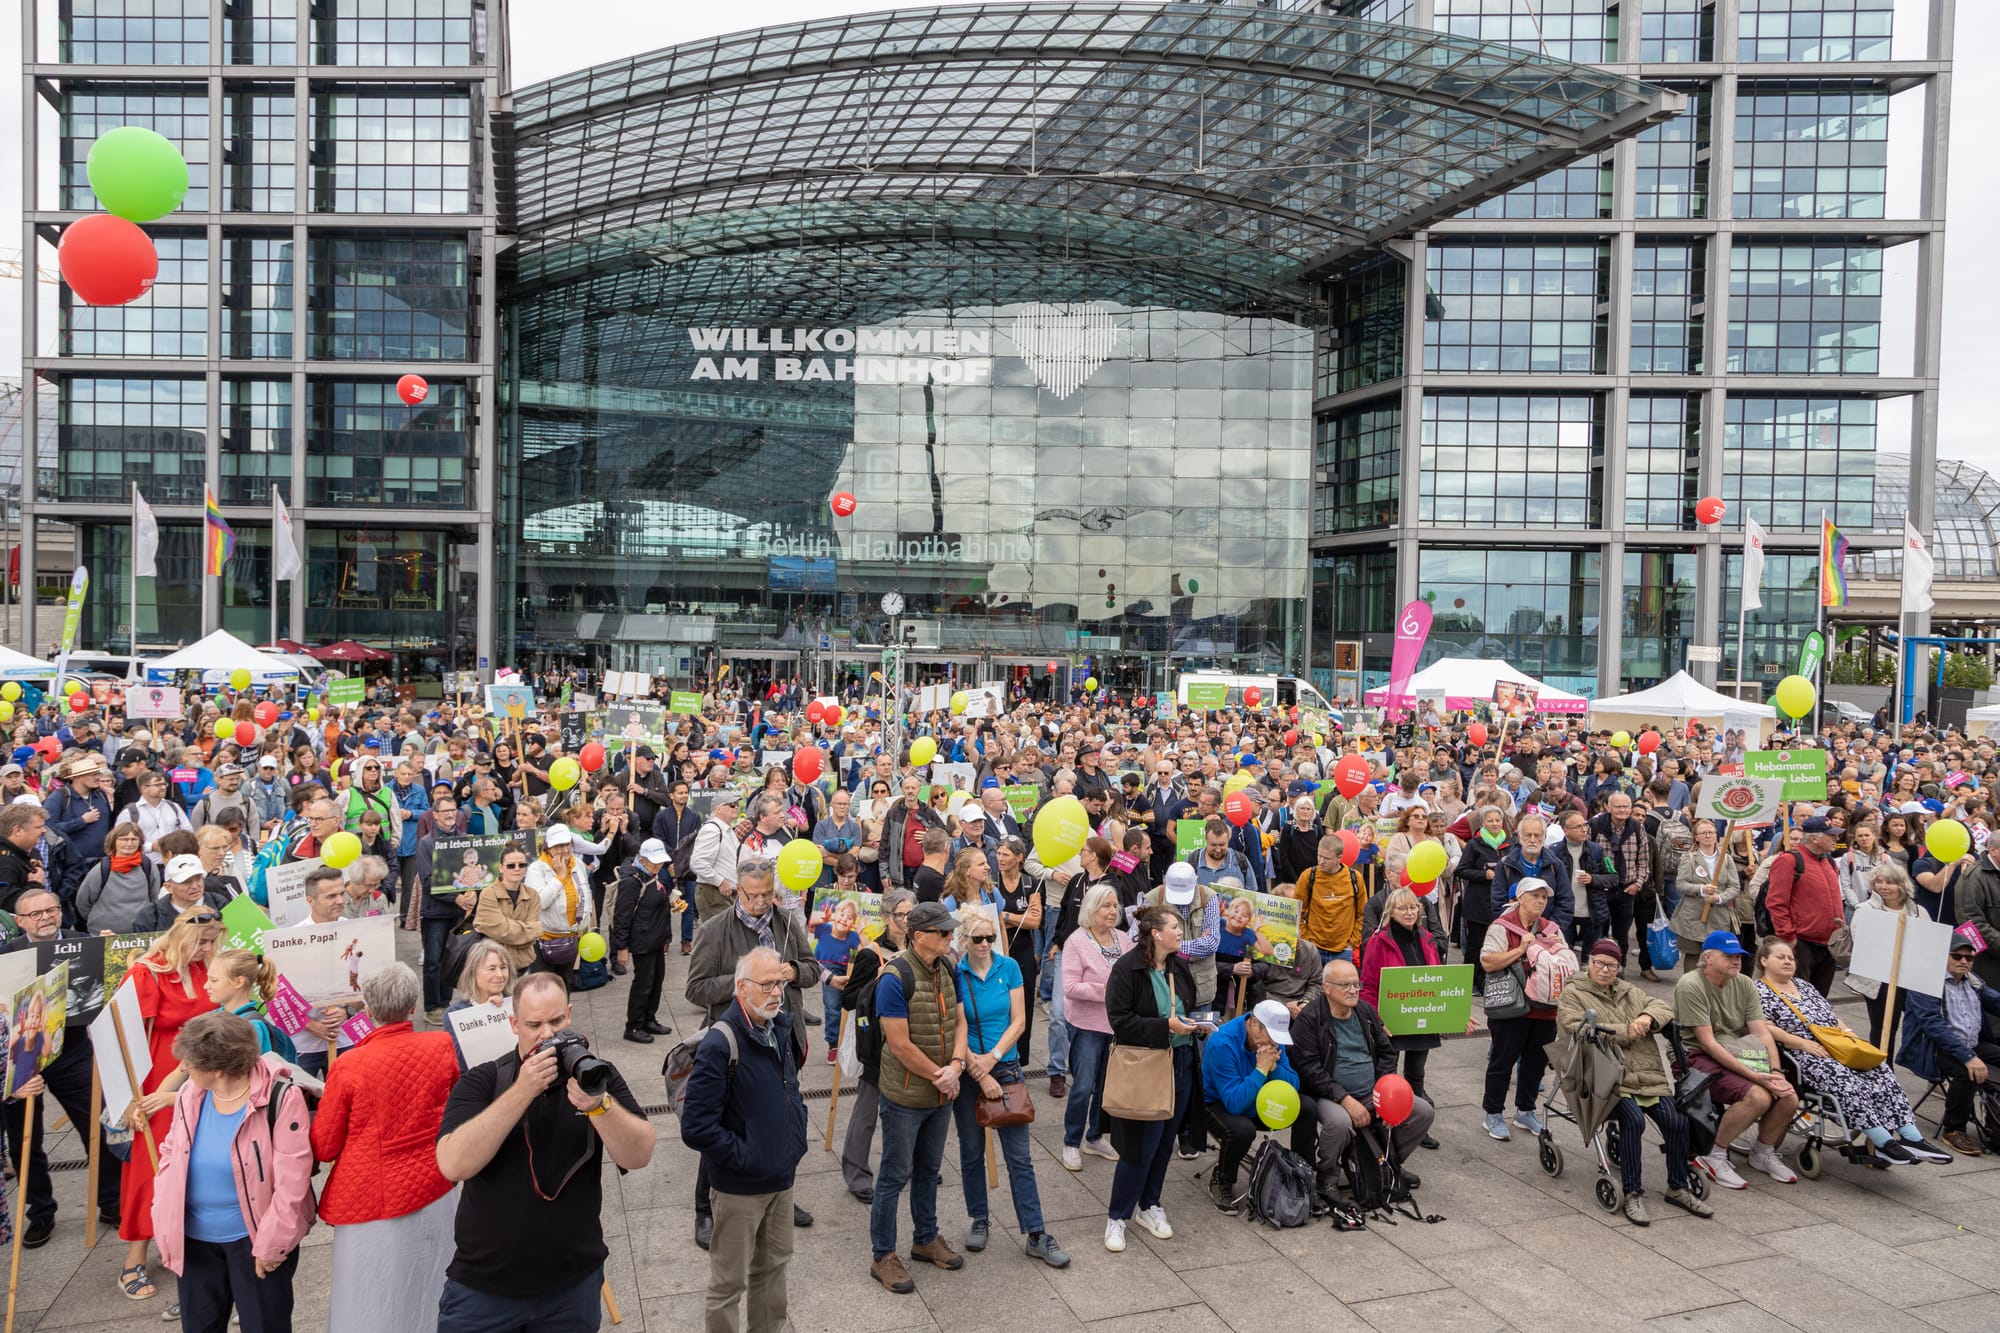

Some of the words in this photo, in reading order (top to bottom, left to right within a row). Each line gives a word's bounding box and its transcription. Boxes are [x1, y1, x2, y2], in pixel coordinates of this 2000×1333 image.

[687, 327, 990, 353] WILLKOMMEN
[690, 357, 759, 381] AM
[775, 357, 990, 383] BAHNHOF
[757, 534, 831, 557] Berlin
[853, 534, 1043, 564] Hauptbahnhof
[1766, 665, 1777, 673] DB
[1754, 762, 1816, 771] Hebammen
[1790, 773, 1821, 783] Leben
[1713, 780, 1733, 799] THANK
[1735, 778, 1752, 786] YOU
[514, 832, 527, 840] Ich!
[434, 841, 448, 850] Das
[449, 839, 471, 849] Leben
[472, 838, 483, 847] ist
[276, 884, 293, 895] Liebe
[286, 890, 304, 902] auch!
[1280, 901, 1291, 911] bin
[1258, 907, 1297, 921] besonders!
[111, 936, 145, 950] Auch
[272, 937, 307, 949] Danke,
[310, 931, 338, 944] Papa!
[54, 942, 82, 955] Ich!
[1411, 973, 1443, 983] Leben
[1387, 988, 1436, 1001] begrüßen,
[1440, 987, 1465, 997] nicht
[1400, 1002, 1446, 1014] beenden!
[458, 1018, 487, 1032] Danke,
[487, 1010, 508, 1024] Papa!
